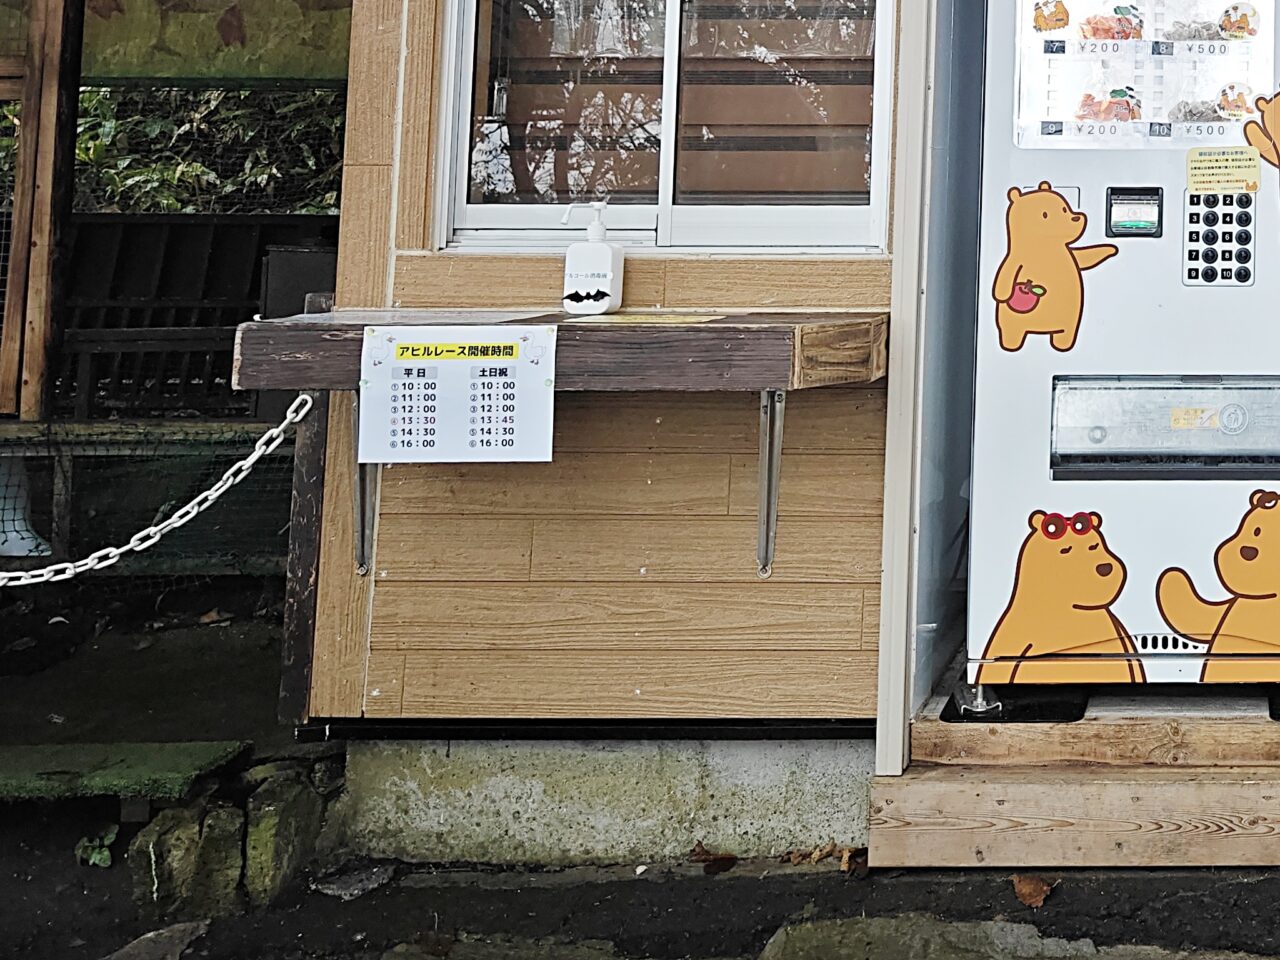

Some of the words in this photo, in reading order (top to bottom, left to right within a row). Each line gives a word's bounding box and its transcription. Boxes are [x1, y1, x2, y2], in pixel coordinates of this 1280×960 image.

[1052, 43, 1058, 51] 7
[1080, 43, 1119, 52] ¥200
[1160, 45, 1166, 53] 8
[1187, 44, 1226, 54] ¥500
[1048, 124, 1055, 132] 9
[1077, 125, 1116, 134] ¥200
[1156, 126, 1167, 135] 10
[1185, 126, 1225, 135] ¥500
[399, 346, 514, 357] アヒルレース開催時間
[404, 368, 426, 378] 平日
[478, 368, 508, 377] 土日祝
